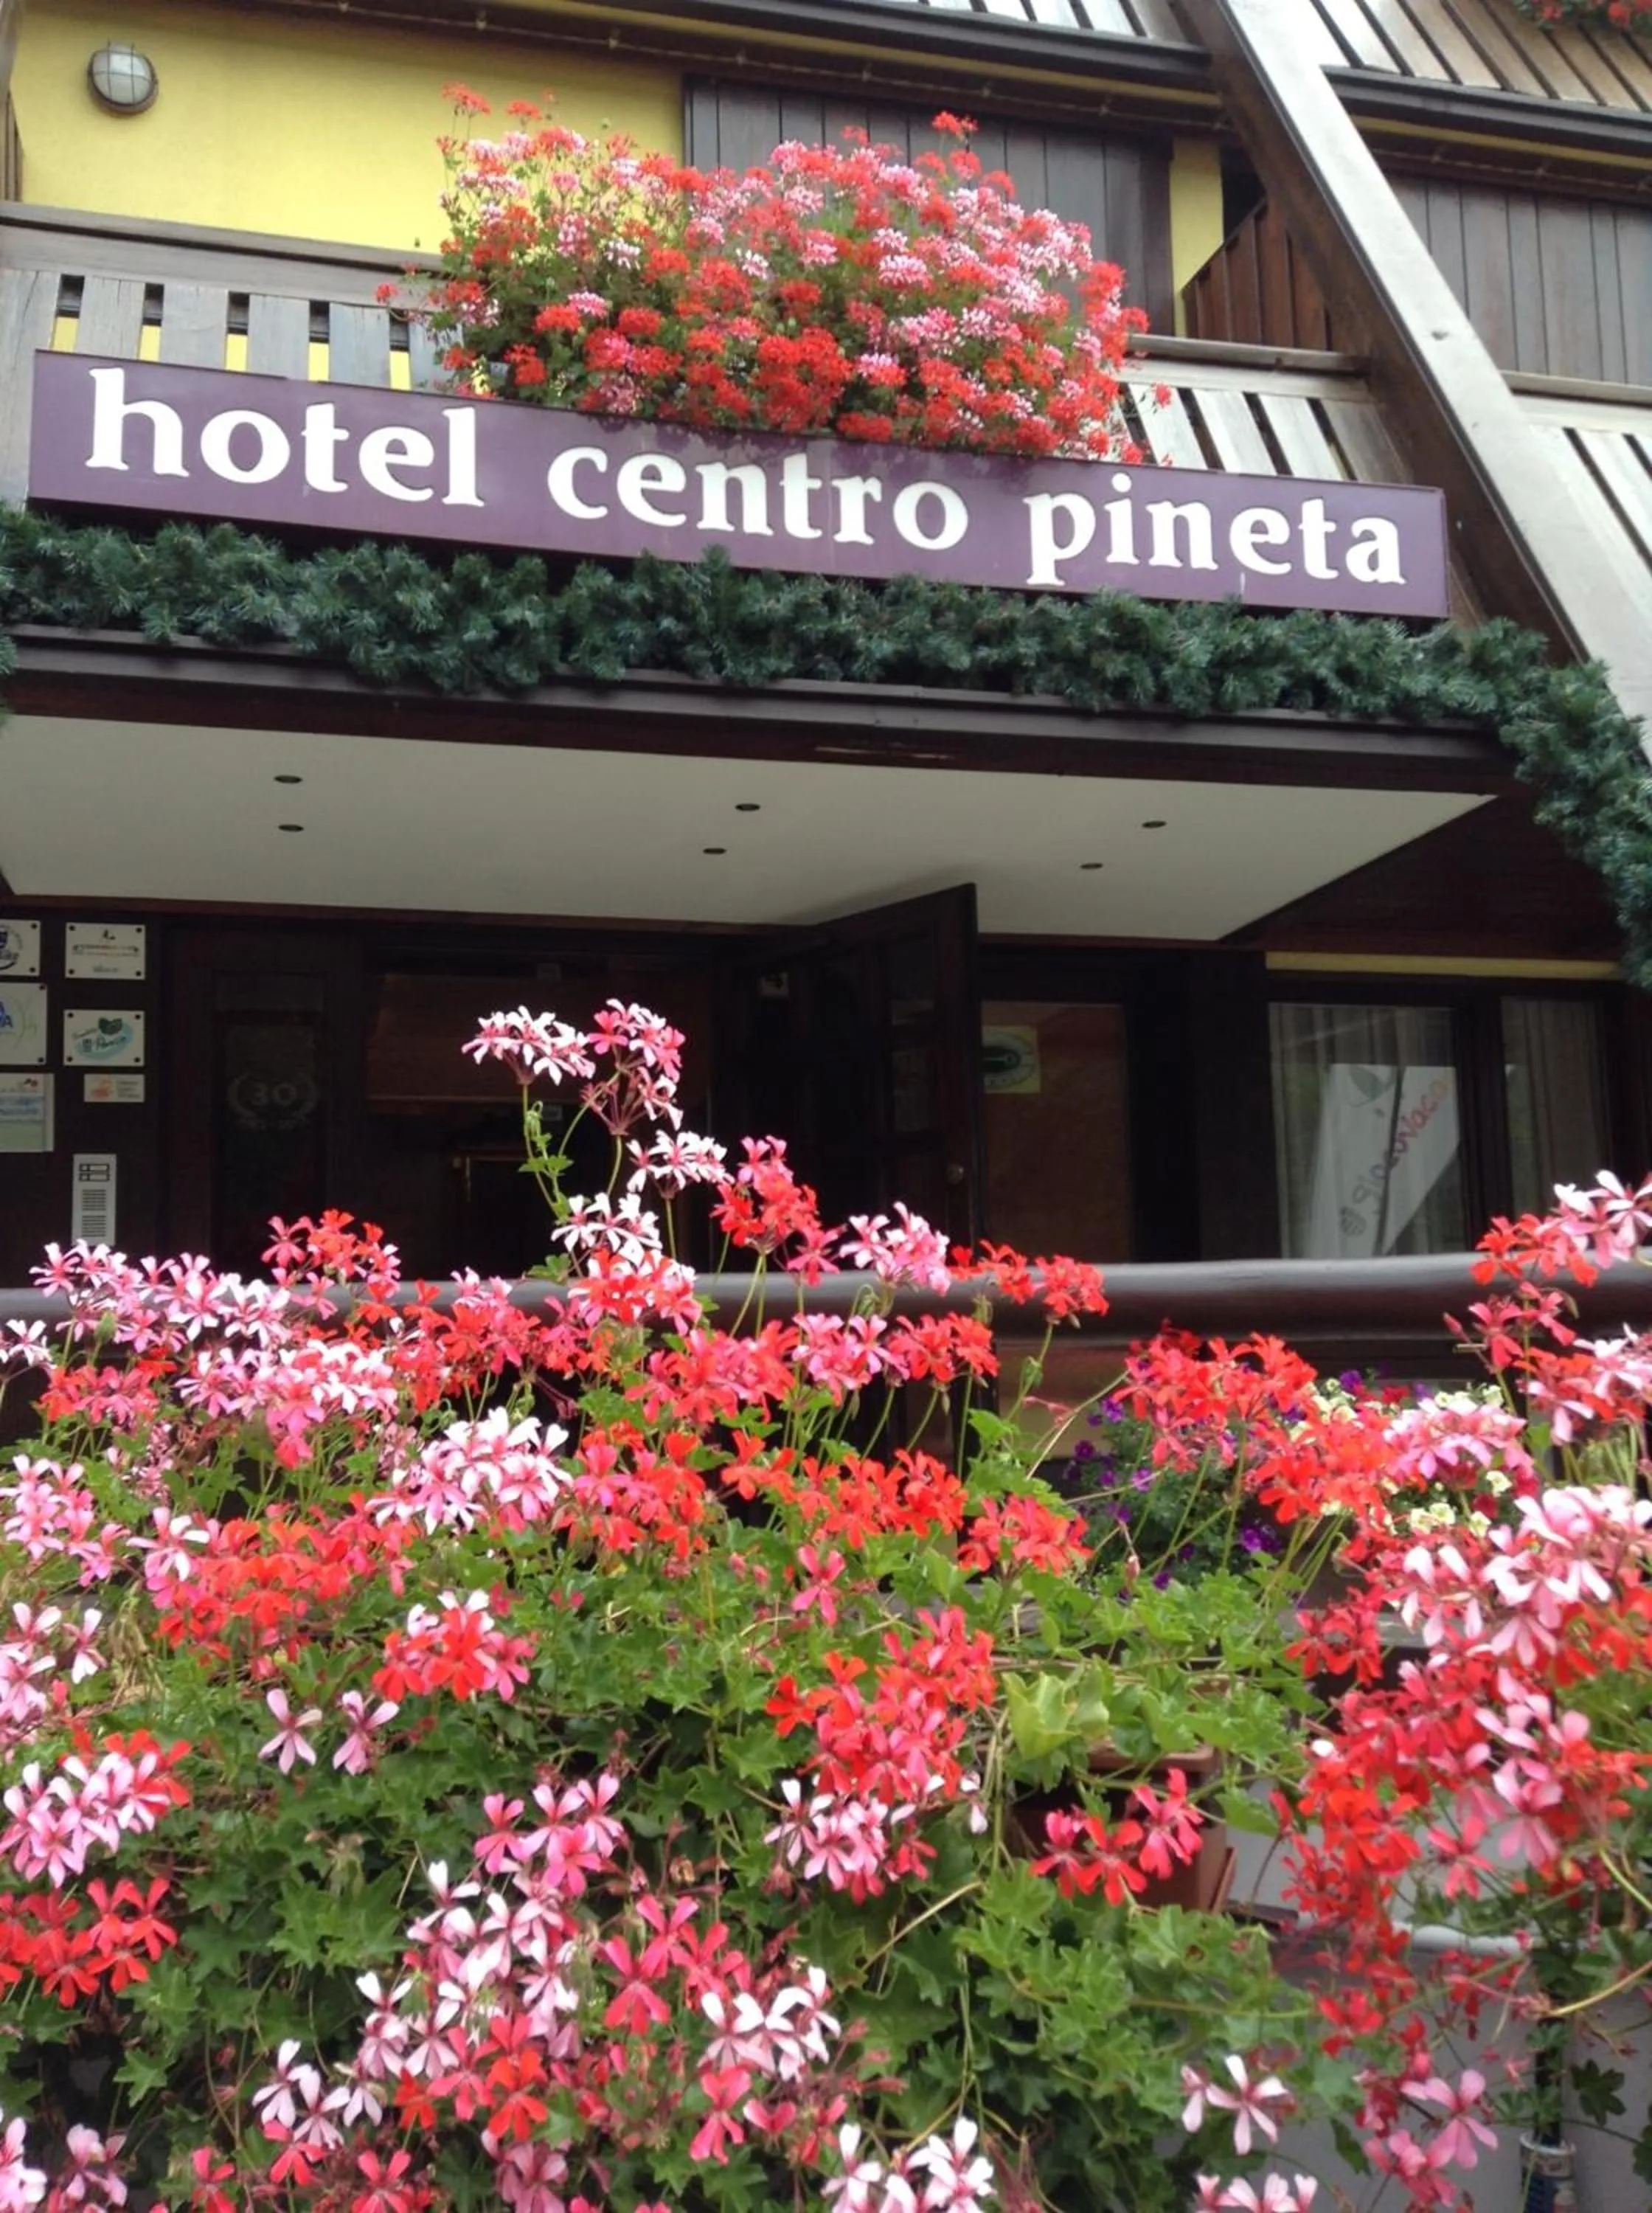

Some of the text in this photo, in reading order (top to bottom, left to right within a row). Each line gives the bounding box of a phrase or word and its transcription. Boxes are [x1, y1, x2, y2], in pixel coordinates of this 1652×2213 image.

[85, 367, 1406, 587] hotel centro pineta
